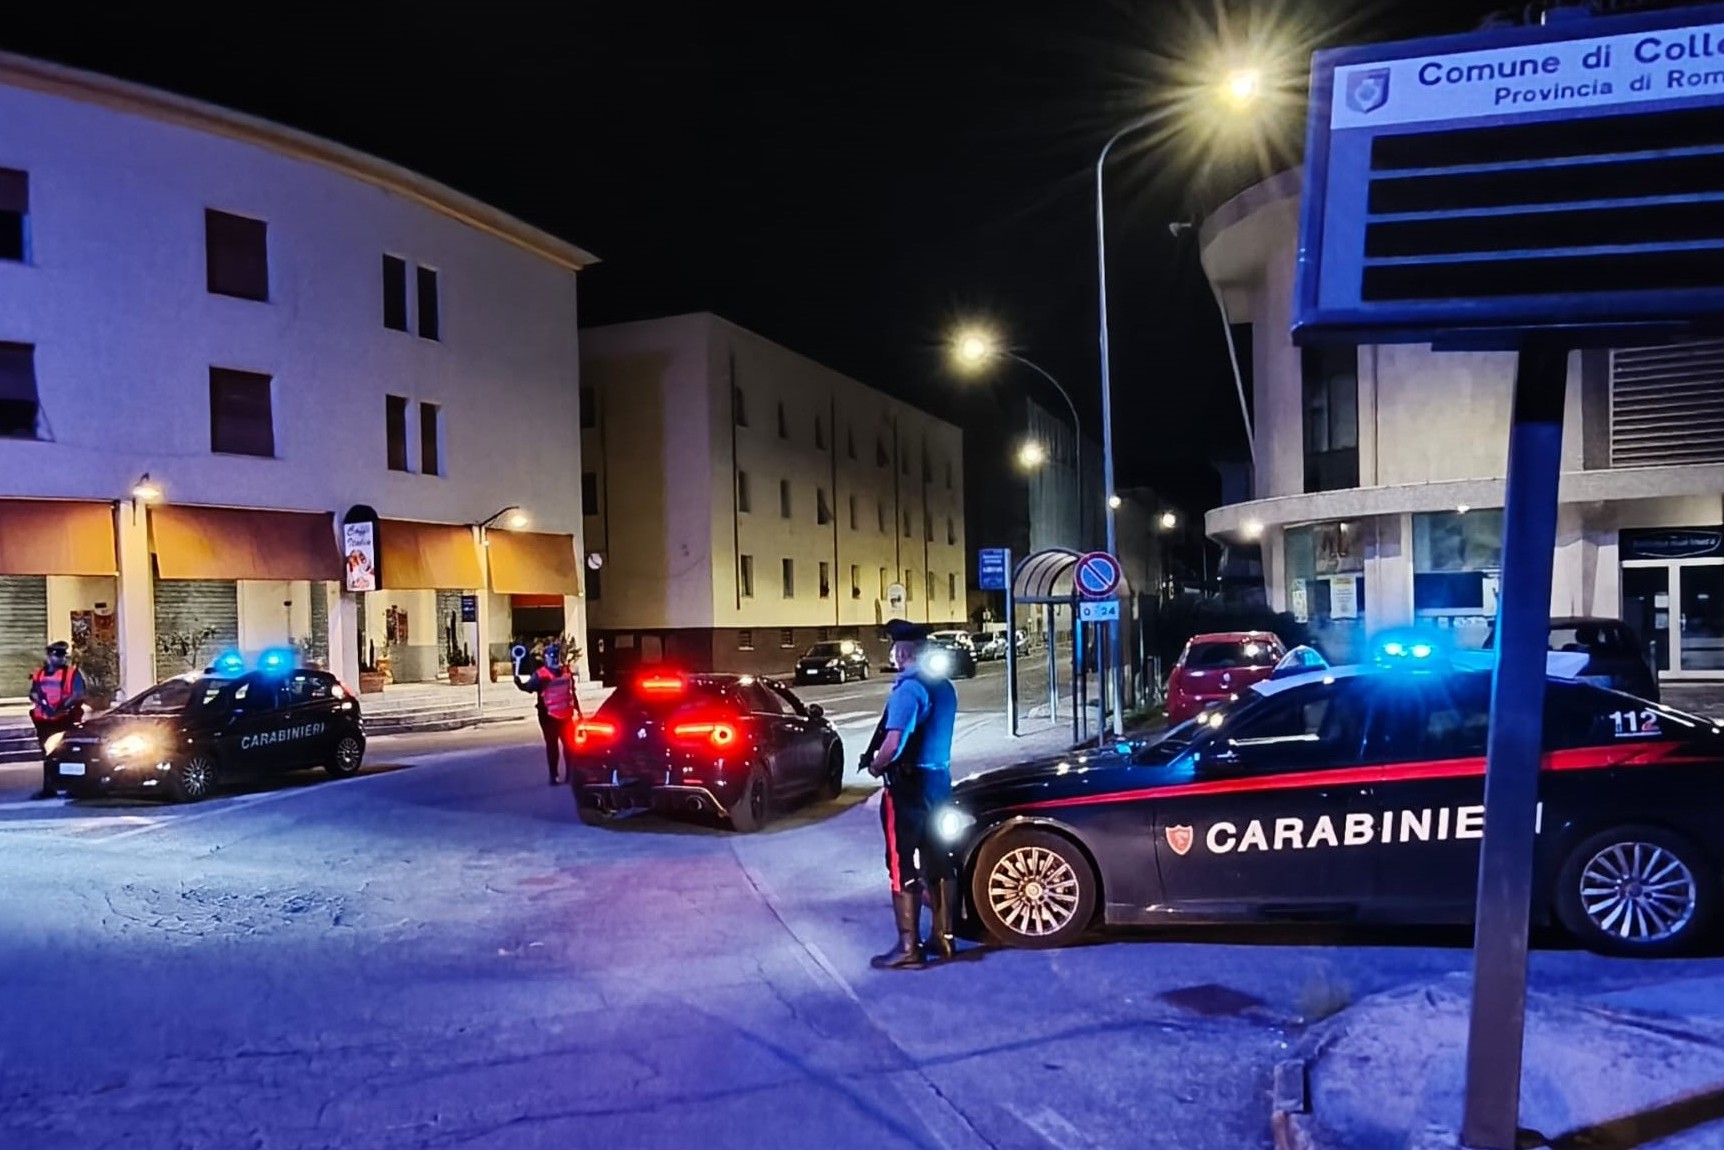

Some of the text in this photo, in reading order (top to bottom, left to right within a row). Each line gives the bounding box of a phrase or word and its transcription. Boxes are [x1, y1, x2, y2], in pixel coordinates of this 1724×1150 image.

[1418, 56, 1561, 86] Comune
[1582, 44, 1611, 70] di
[1494, 79, 1613, 106] Provincia
[1629, 73, 1651, 92] di
[1101, 606, 1115, 616] 24
[241, 722, 324, 749] CARABINIERI
[1609, 711, 1660, 733] 112
[1206, 802, 1543, 853] CARABINIEI
